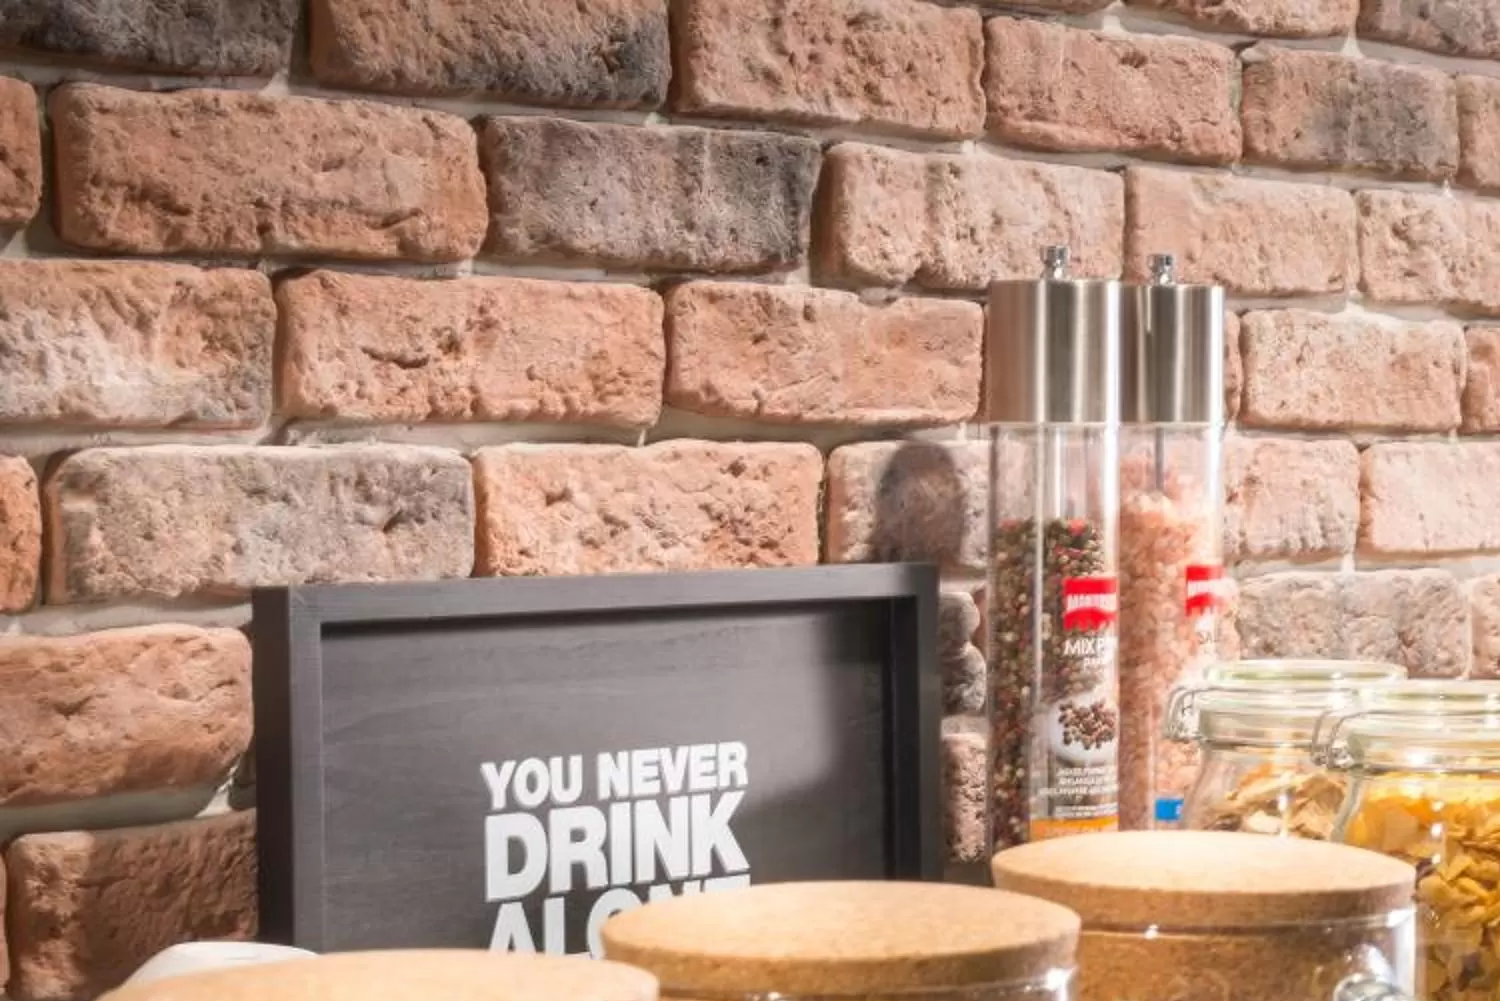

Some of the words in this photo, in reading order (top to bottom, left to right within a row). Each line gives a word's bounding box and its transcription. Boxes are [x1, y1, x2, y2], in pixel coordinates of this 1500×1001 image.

[481, 755, 582, 811] YOU
[598, 741, 748, 800] NEVER
[485, 790, 749, 902] DRINK
[488, 874, 750, 959] ALO
